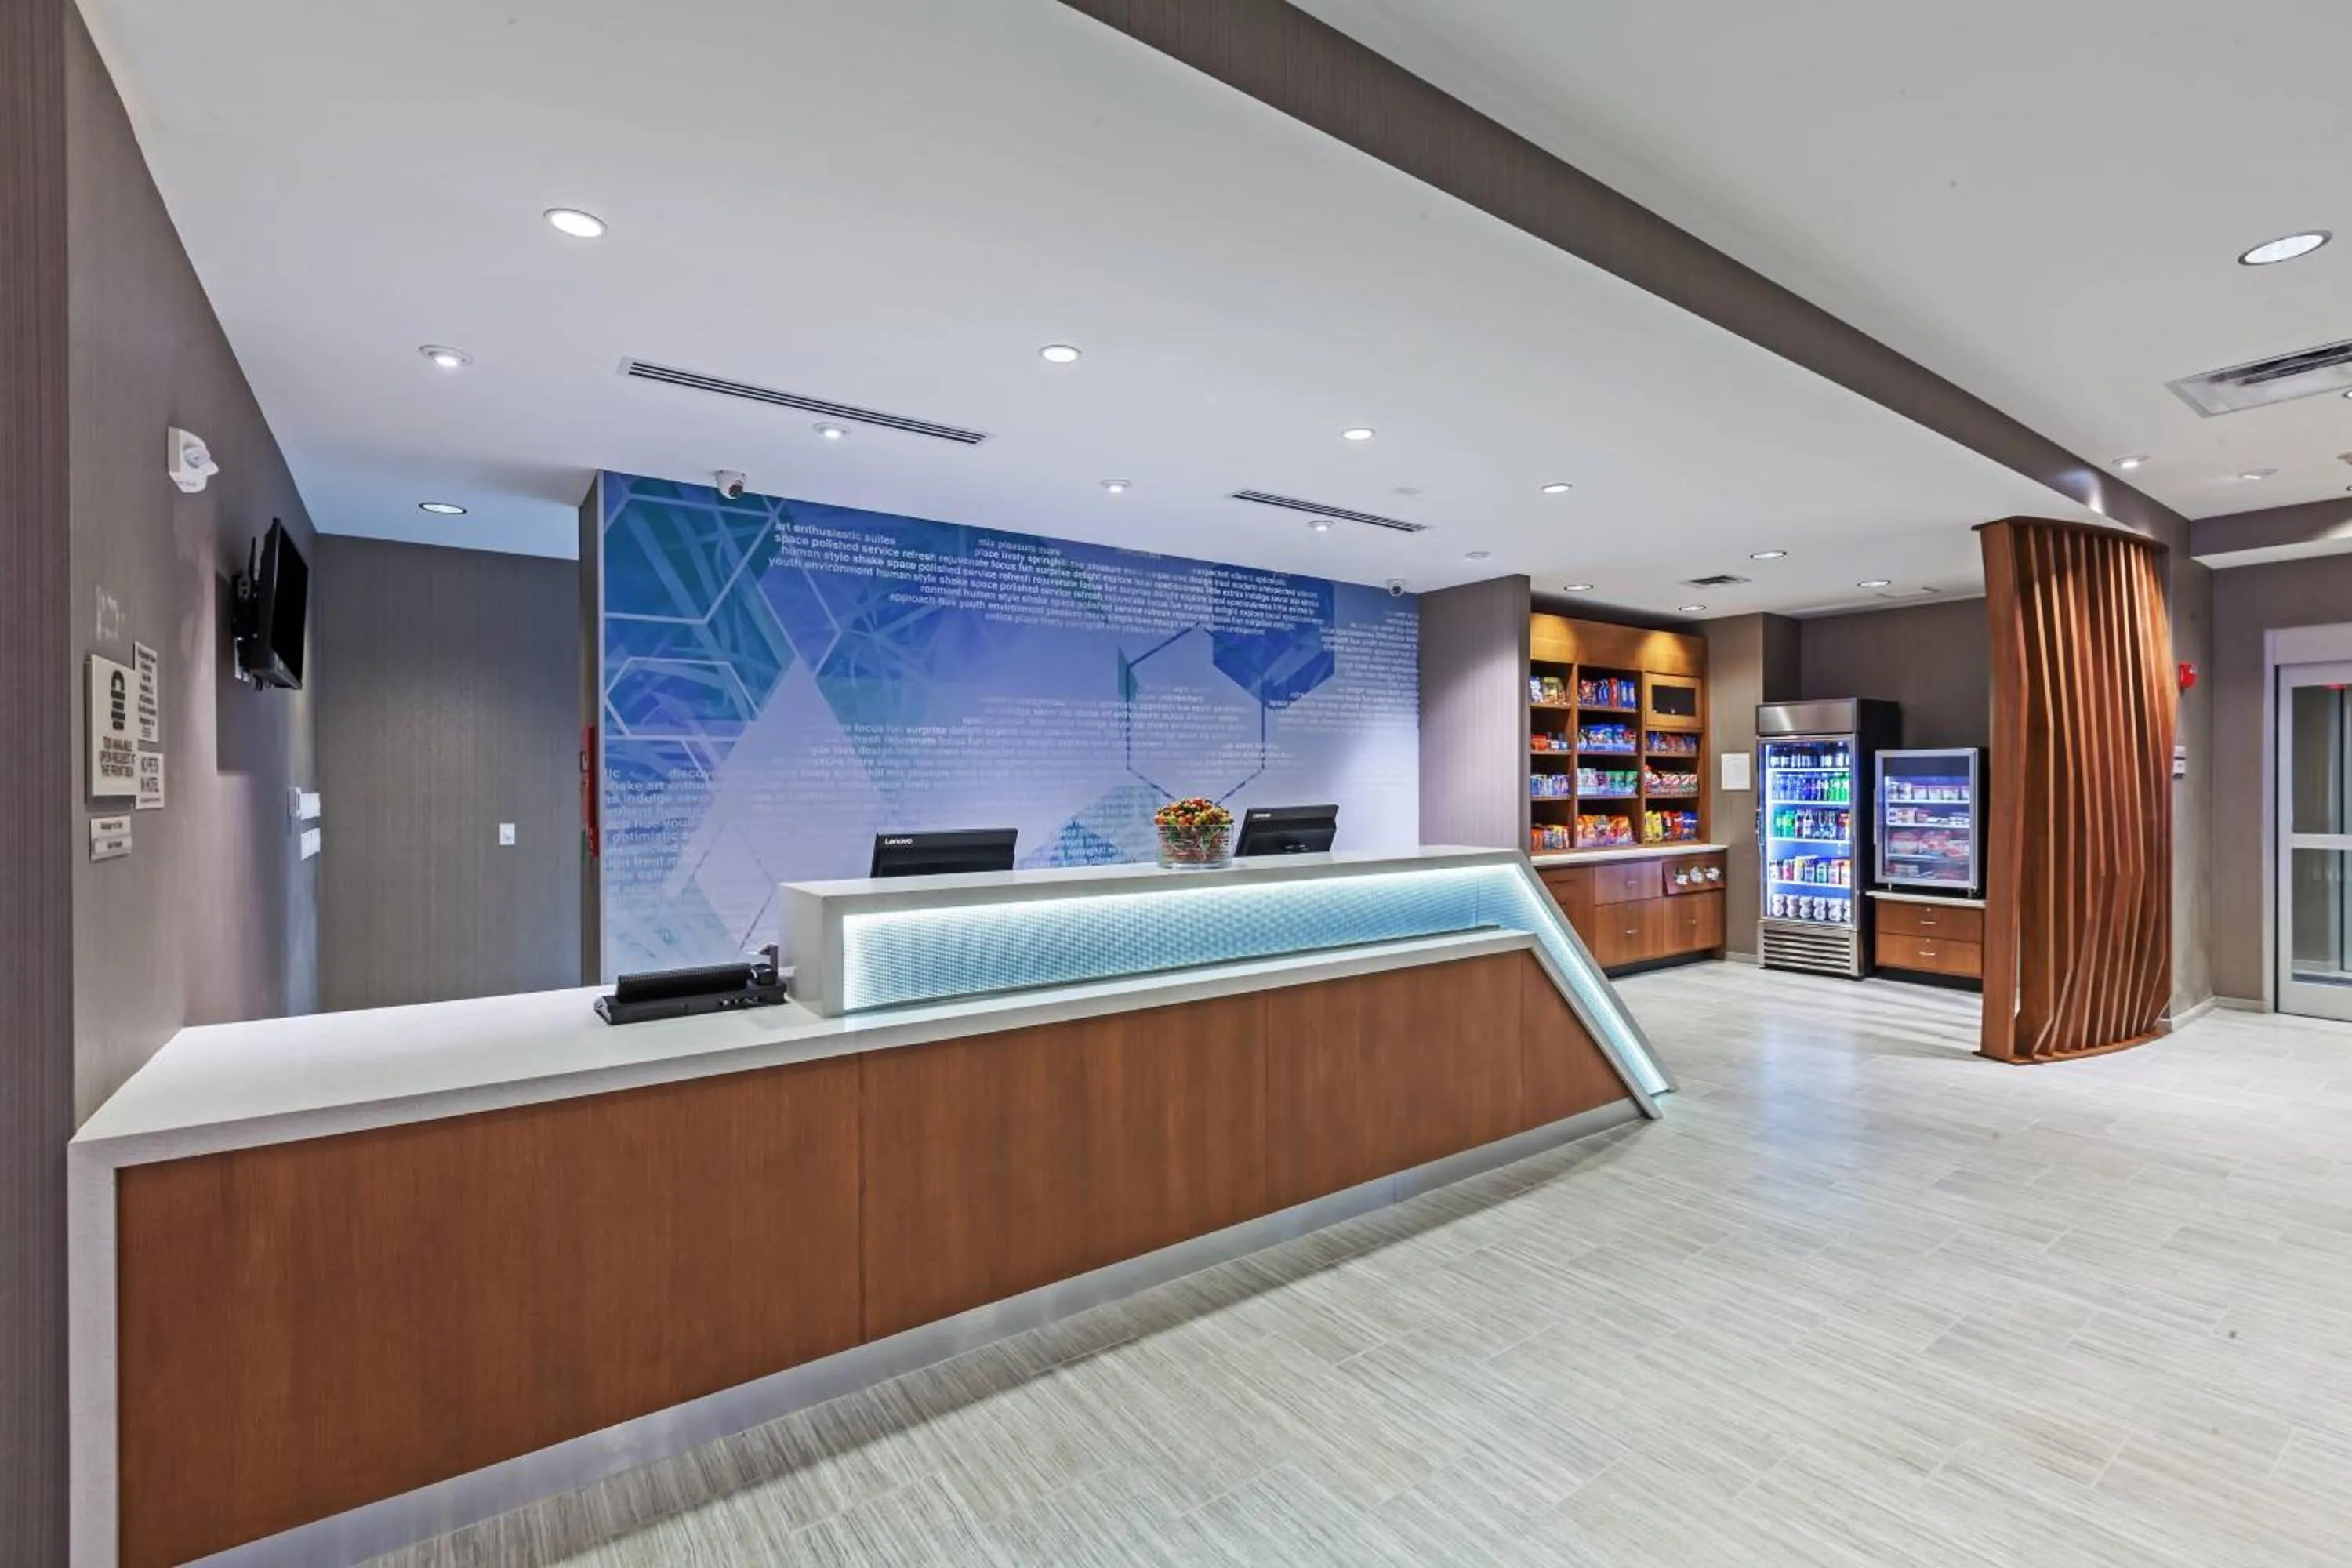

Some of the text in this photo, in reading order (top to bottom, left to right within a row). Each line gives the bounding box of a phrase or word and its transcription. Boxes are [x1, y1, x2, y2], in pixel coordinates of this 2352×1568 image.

[775, 521, 895, 545] art enthusiastic suites
[978, 537, 995, 547] mix
[774, 535, 808, 547] space
[811, 537, 858, 554] polished
[862, 544, 898, 557] service
[902, 549, 936, 561] refresh
[938, 554, 988, 569] rejuvenate
[990, 560, 1016, 570] focus
[1019, 563, 1034, 572] fun
[1036, 565, 1070, 579] surprise
[1072, 570, 1100, 582] delight
[1103, 574, 1131, 586] explore
[1222, 589, 1243, 597] extras
[781, 545, 822, 558] human
[825, 550, 850, 564] style
[852, 554, 883, 565] shake
[887, 561, 916, 572] space
[918, 562, 960, 576] polished
[962, 567, 996, 579] service
[998, 572, 1030, 583] refresh
[1033, 575, 1078, 590] rejuvenate
[1080, 581, 1102, 590] focus
[975, 547, 998, 560] place
[1000, 551, 1024, 563] lively
[1028, 554, 1068, 568] springhill
[1258, 585, 1294, 597] unexpected
[769, 555, 801, 570] youth
[804, 560, 873, 575] environment
[876, 568, 911, 579] human
[913, 572, 936, 584] style
[939, 575, 967, 585] shake
[971, 580, 997, 590] space
[1000, 581, 1038, 594] polished
[1040, 586, 1071, 596] service
[1073, 590, 1102, 599] refresh
[1239, 608, 1264, 619] explore
[963, 588, 996, 598] human
[997, 591, 1019, 603] style
[1022, 594, 1047, 604] shake
[889, 592, 936, 606] approach
[938, 597, 956, 606] hue
[960, 598, 985, 610] youth
[988, 601, 1043, 613] environment
[906, 724, 947, 735] surprise
[884, 735, 936, 746] rejuvenate
[860, 746, 892, 757] design
[612, 827, 678, 845] optimistic
